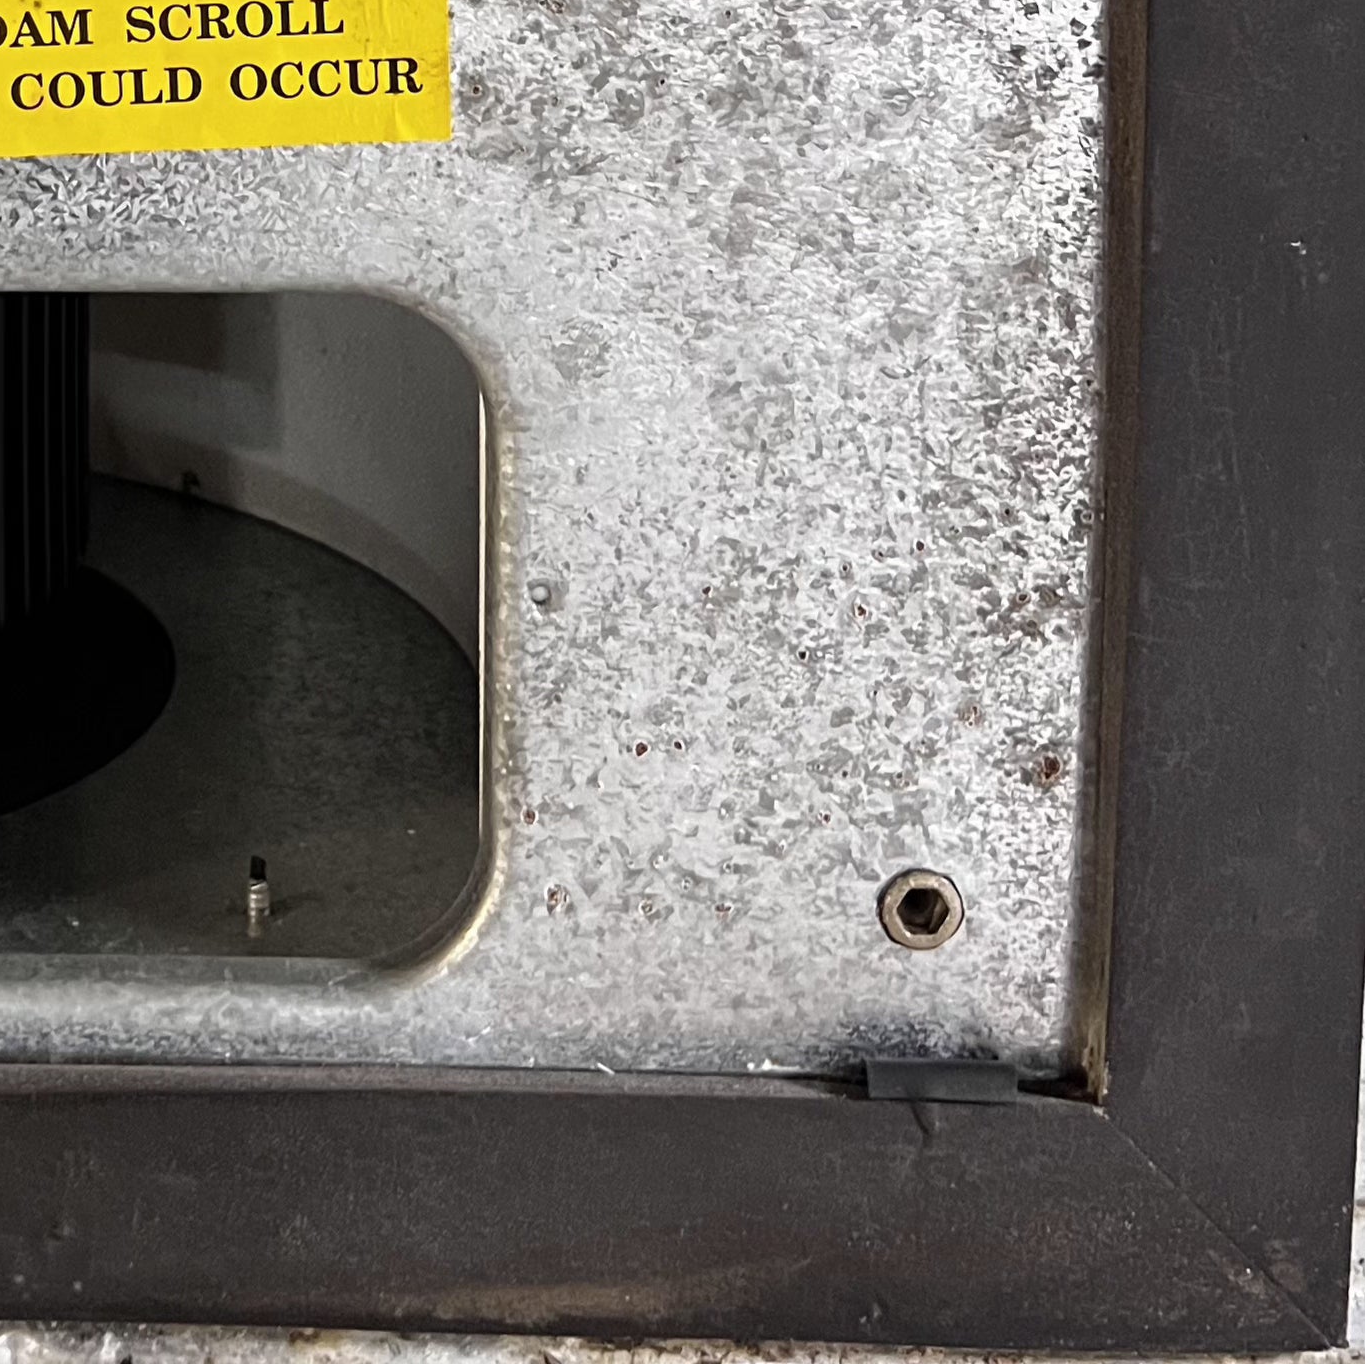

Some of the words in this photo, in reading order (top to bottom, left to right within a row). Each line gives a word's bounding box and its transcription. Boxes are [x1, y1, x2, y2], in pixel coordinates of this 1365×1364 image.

[127, 0, 343, 42] SCROLL
[11, 67, 201, 110] COULD
[230, 58, 423, 100] OCCUR
